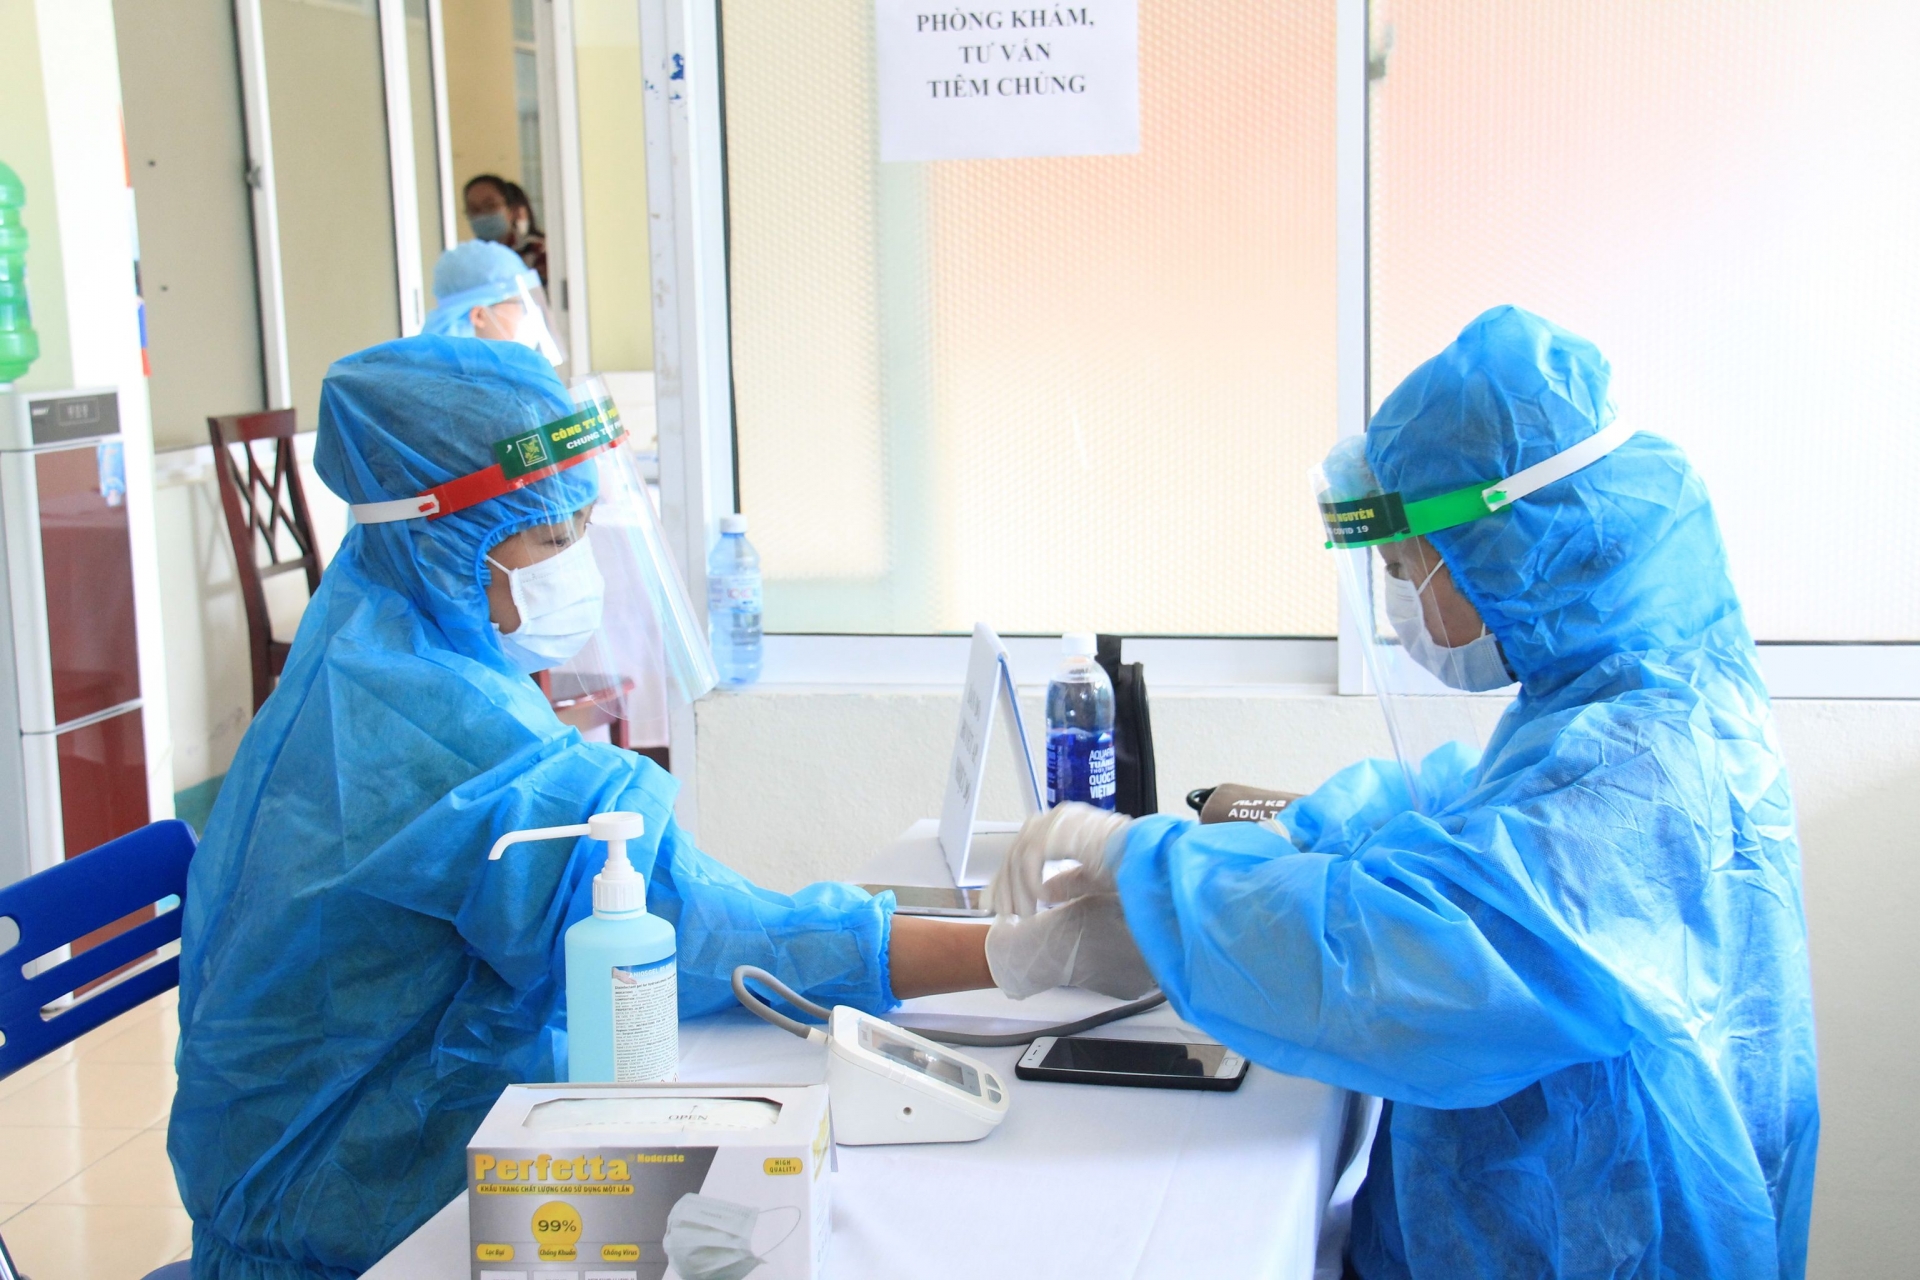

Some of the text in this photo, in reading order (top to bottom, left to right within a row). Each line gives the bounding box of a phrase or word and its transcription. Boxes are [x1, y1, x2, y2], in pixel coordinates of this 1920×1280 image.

[916, 3, 1095, 32] PHÒNG KHÁM,
[958, 38, 1051, 64] TƯ VẤN
[926, 74, 989, 98] TIÊM
[551, 424, 582, 441] CÔNG
[582, 417, 596, 430] TY
[566, 431, 600, 449] CHUNG
[1334, 525, 1369, 535] COVID 19
[1228, 808, 1278, 820] ADULT
[474, 1153, 685, 1181] Perfetta Moderate
[499, 1185, 520, 1193] TRANG
[560, 1185, 573, 1193] CAO
[538, 1219, 577, 1232] 99%
